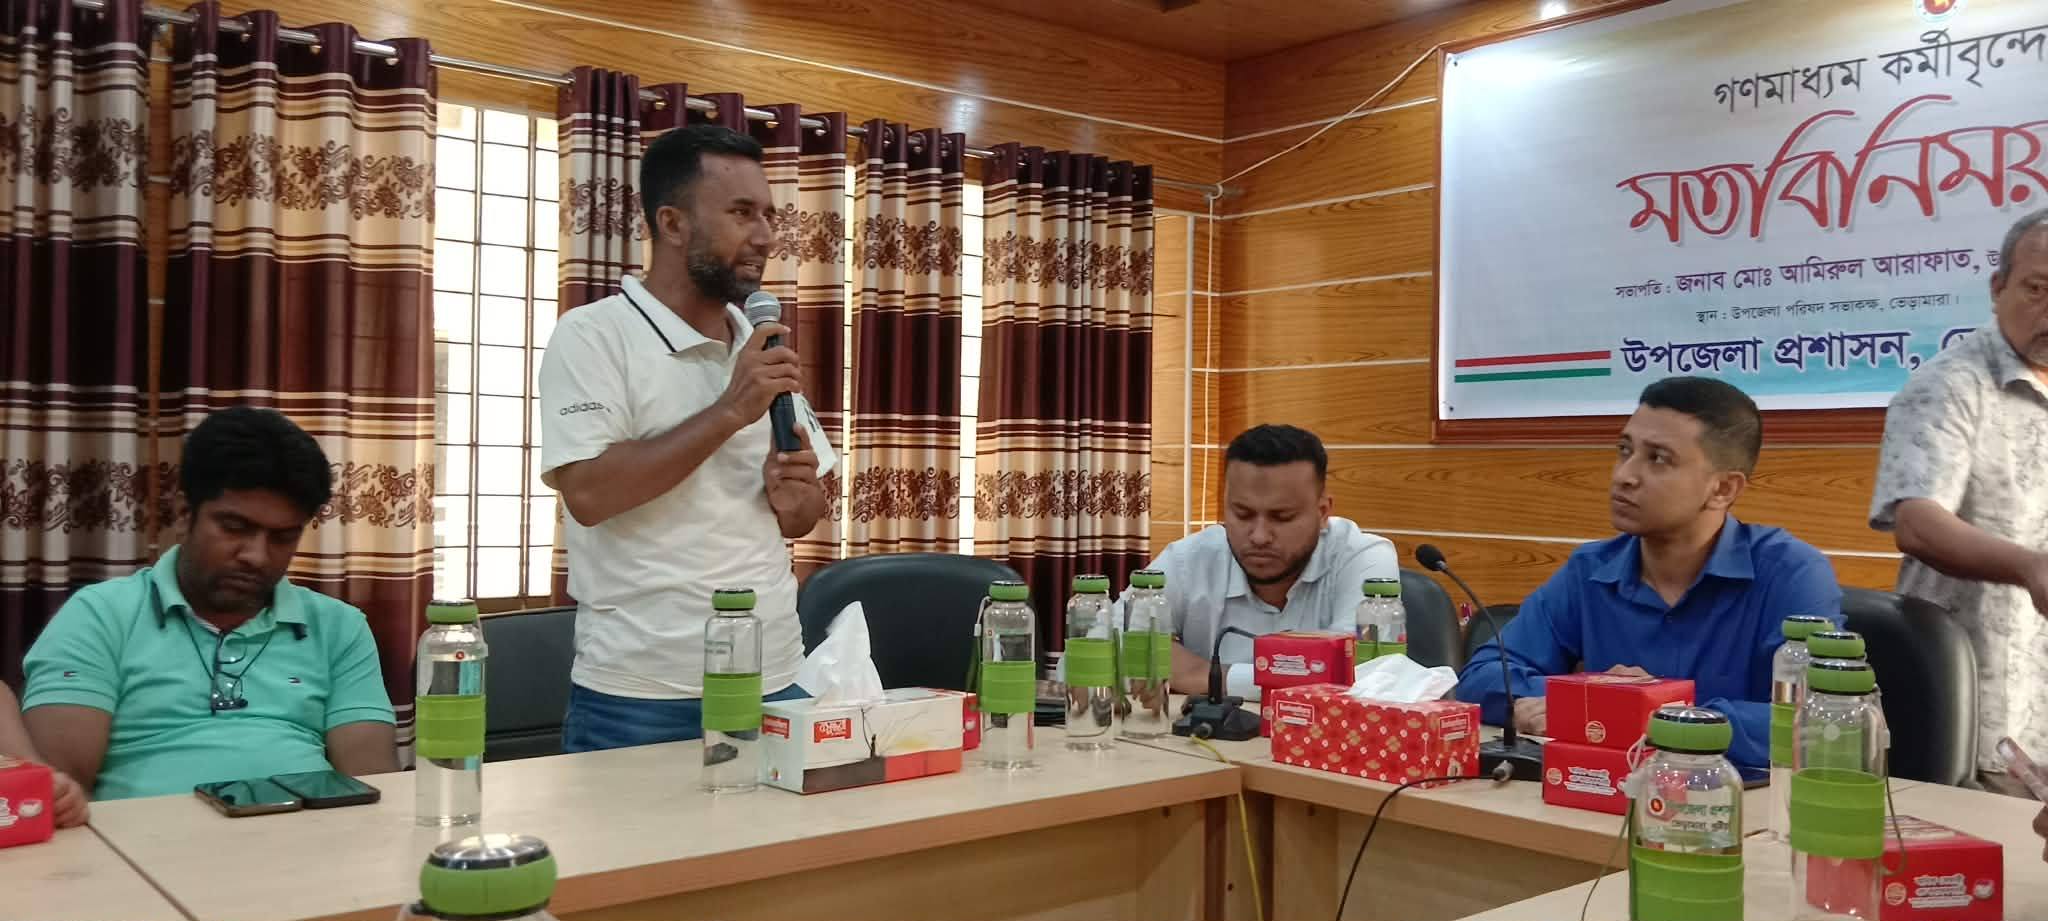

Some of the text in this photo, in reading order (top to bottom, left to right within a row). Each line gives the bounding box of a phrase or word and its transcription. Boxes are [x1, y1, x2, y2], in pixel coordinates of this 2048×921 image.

[1714, 58, 1868, 112] গণমাধ্যম
[1614, 280, 1664, 299] সভাপতি
[1675, 271, 1727, 293] জনাব
[1734, 267, 1773, 289] মোঃ
[1779, 255, 1865, 285] আমিরুল
[1872, 247, 1981, 277] আরাফাত,
[1731, 305, 1781, 320] উপজেলা
[1620, 337, 1764, 373] উপজেলা
[1774, 331, 1921, 371] প্রশাসন,
[560, 401, 604, 416] adidas
